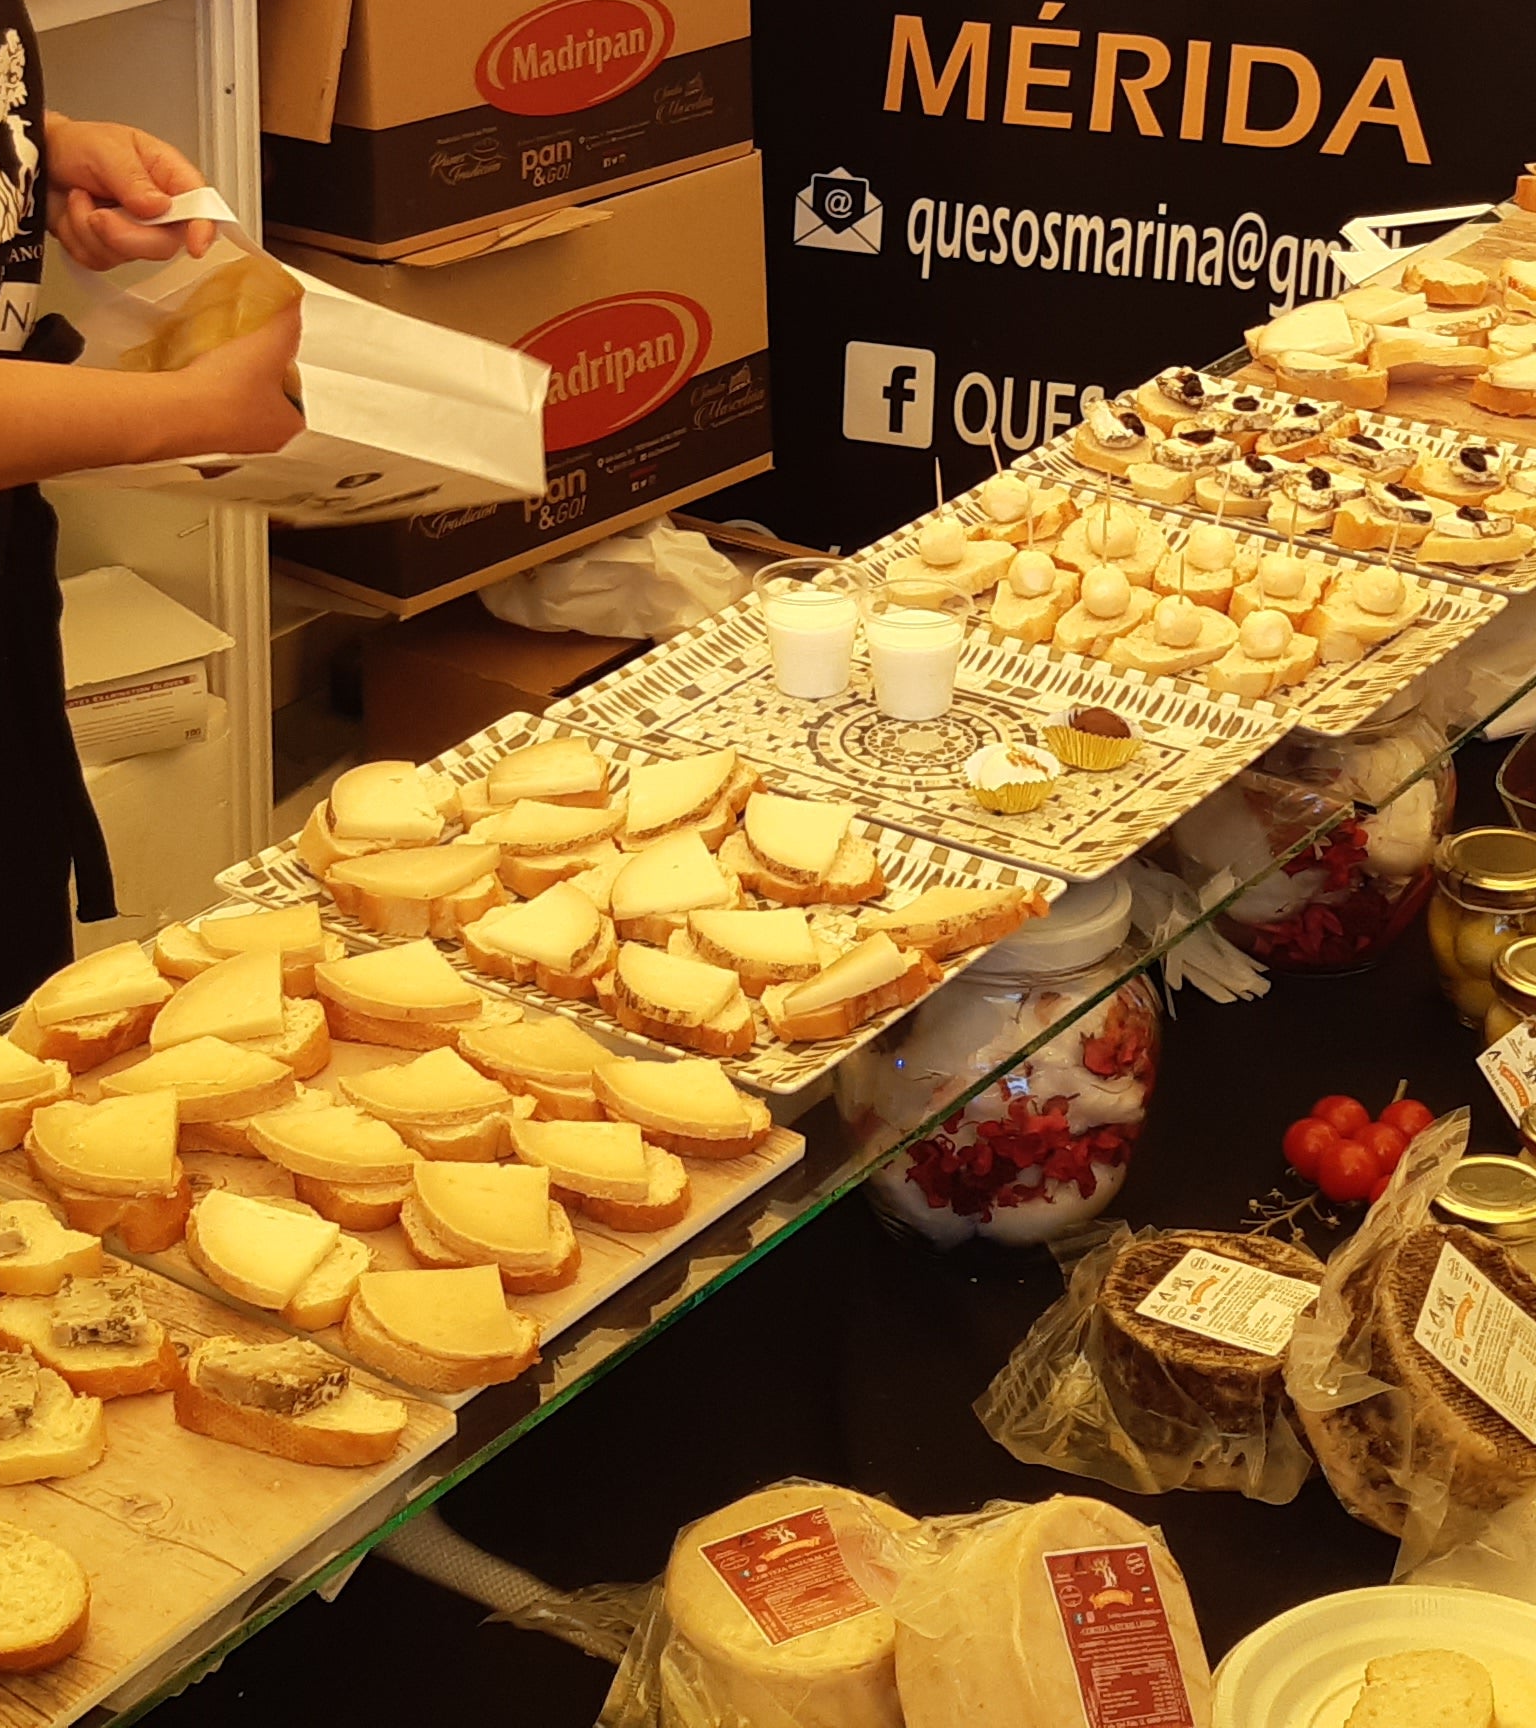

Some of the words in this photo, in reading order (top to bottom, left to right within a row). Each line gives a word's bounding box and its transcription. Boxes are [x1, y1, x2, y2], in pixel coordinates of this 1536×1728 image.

[512, 21, 646, 85] Madripan
[883, 1, 1433, 165] MÉRIDA
[521, 139, 573, 180] pan
[907, 196, 1401, 318] quesosmarina@gm
[547, 332, 676, 406] adripan
